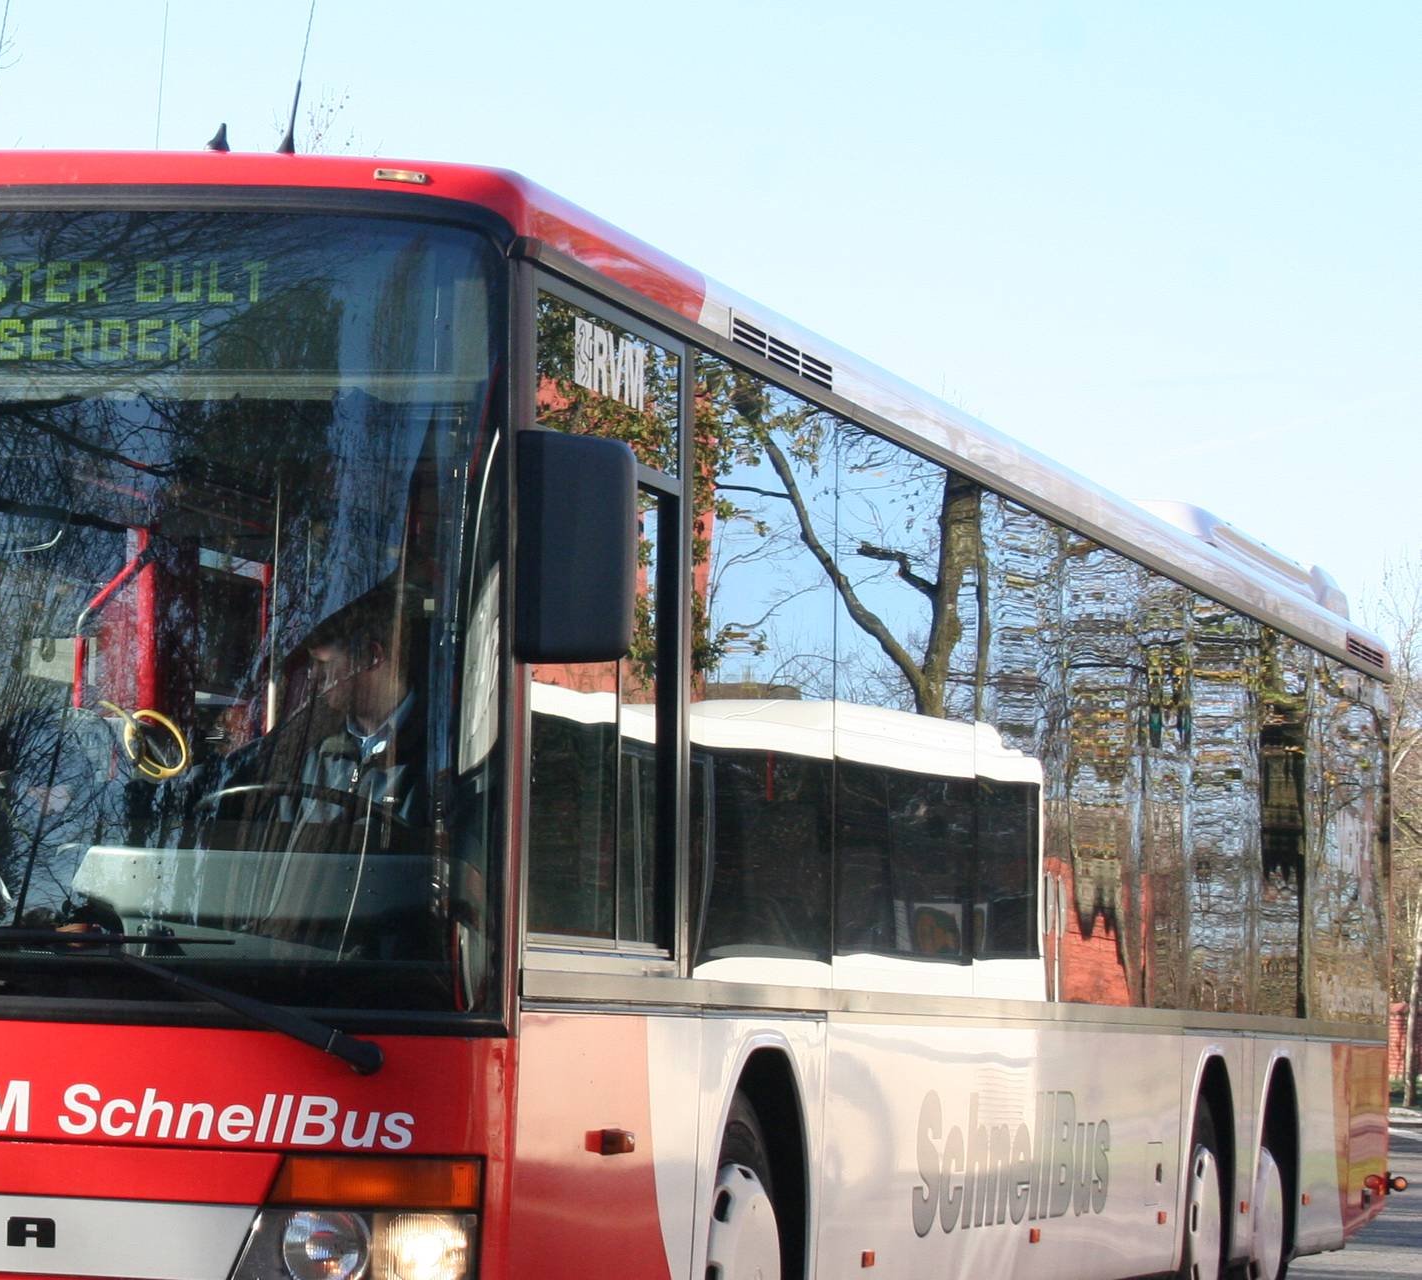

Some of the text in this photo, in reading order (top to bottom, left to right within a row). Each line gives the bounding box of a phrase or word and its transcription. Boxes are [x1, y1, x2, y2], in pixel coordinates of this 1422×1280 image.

[135, 261, 267, 303] BÜLT
[594, 325, 644, 412] RVM
[58, 1083, 414, 1150] SchnellBus
[912, 1089, 1111, 1238] SchnellBus
